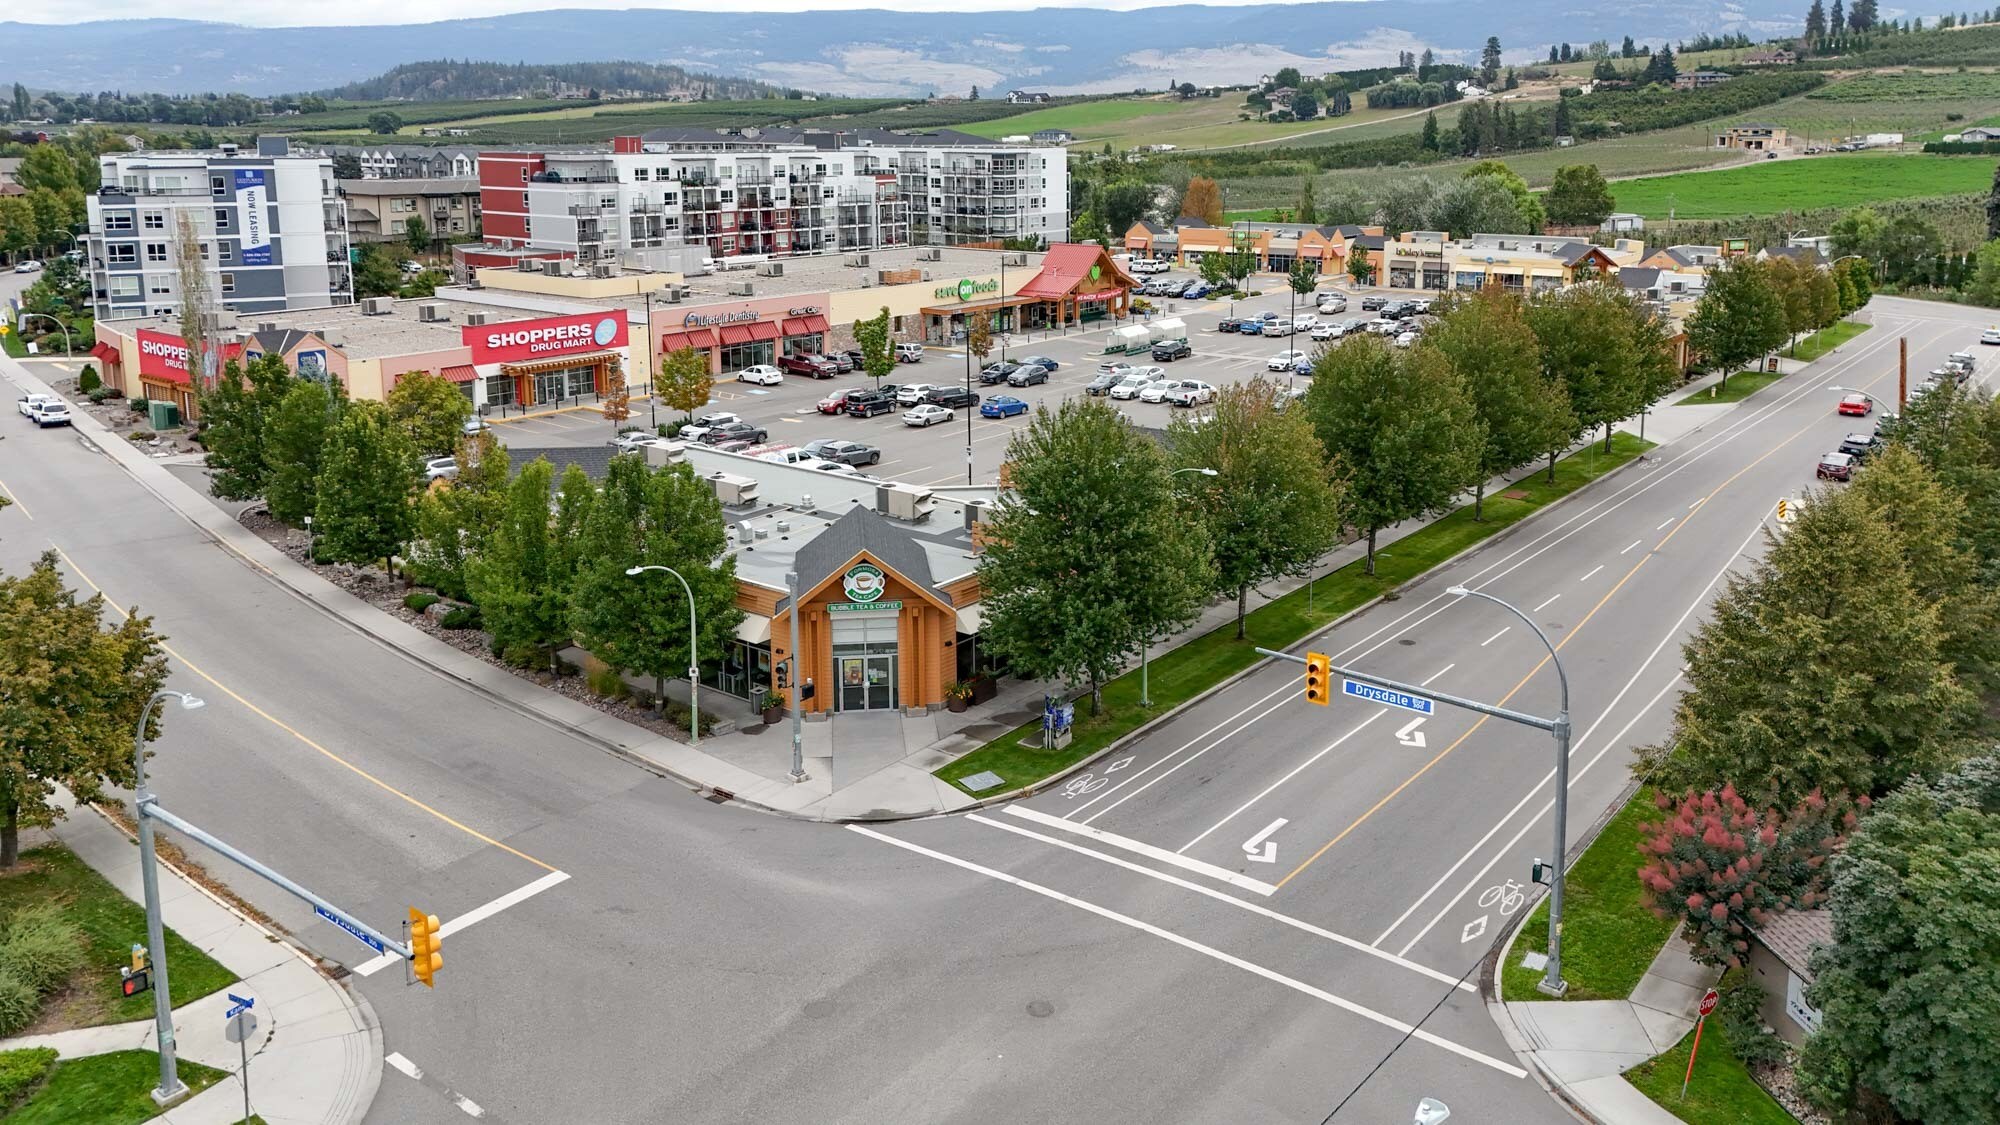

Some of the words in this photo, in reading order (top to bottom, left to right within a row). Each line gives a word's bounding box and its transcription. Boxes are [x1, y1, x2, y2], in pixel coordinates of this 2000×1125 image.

[247, 190, 256, 209] NOW
[248, 210, 260, 245] LEASING
[960, 284, 973, 294] on
[700, 312, 729, 327] Lifestyle
[729, 310, 760, 323] Dentistry
[790, 307, 806, 316] Great
[487, 323, 593, 349] SHOPPERS
[141, 340, 189, 361] SHOPPE
[530, 340, 561, 353] DRUG
[563, 337, 593, 349] MART
[165, 358, 183, 369] DRUG
[849, 566, 879, 577] FORMOSA
[852, 591, 863, 600] TEA
[830, 604, 855, 612] BUBBLE
[1355, 684, 1409, 706] Drysdale
[1700, 996, 1717, 1011] STOP
